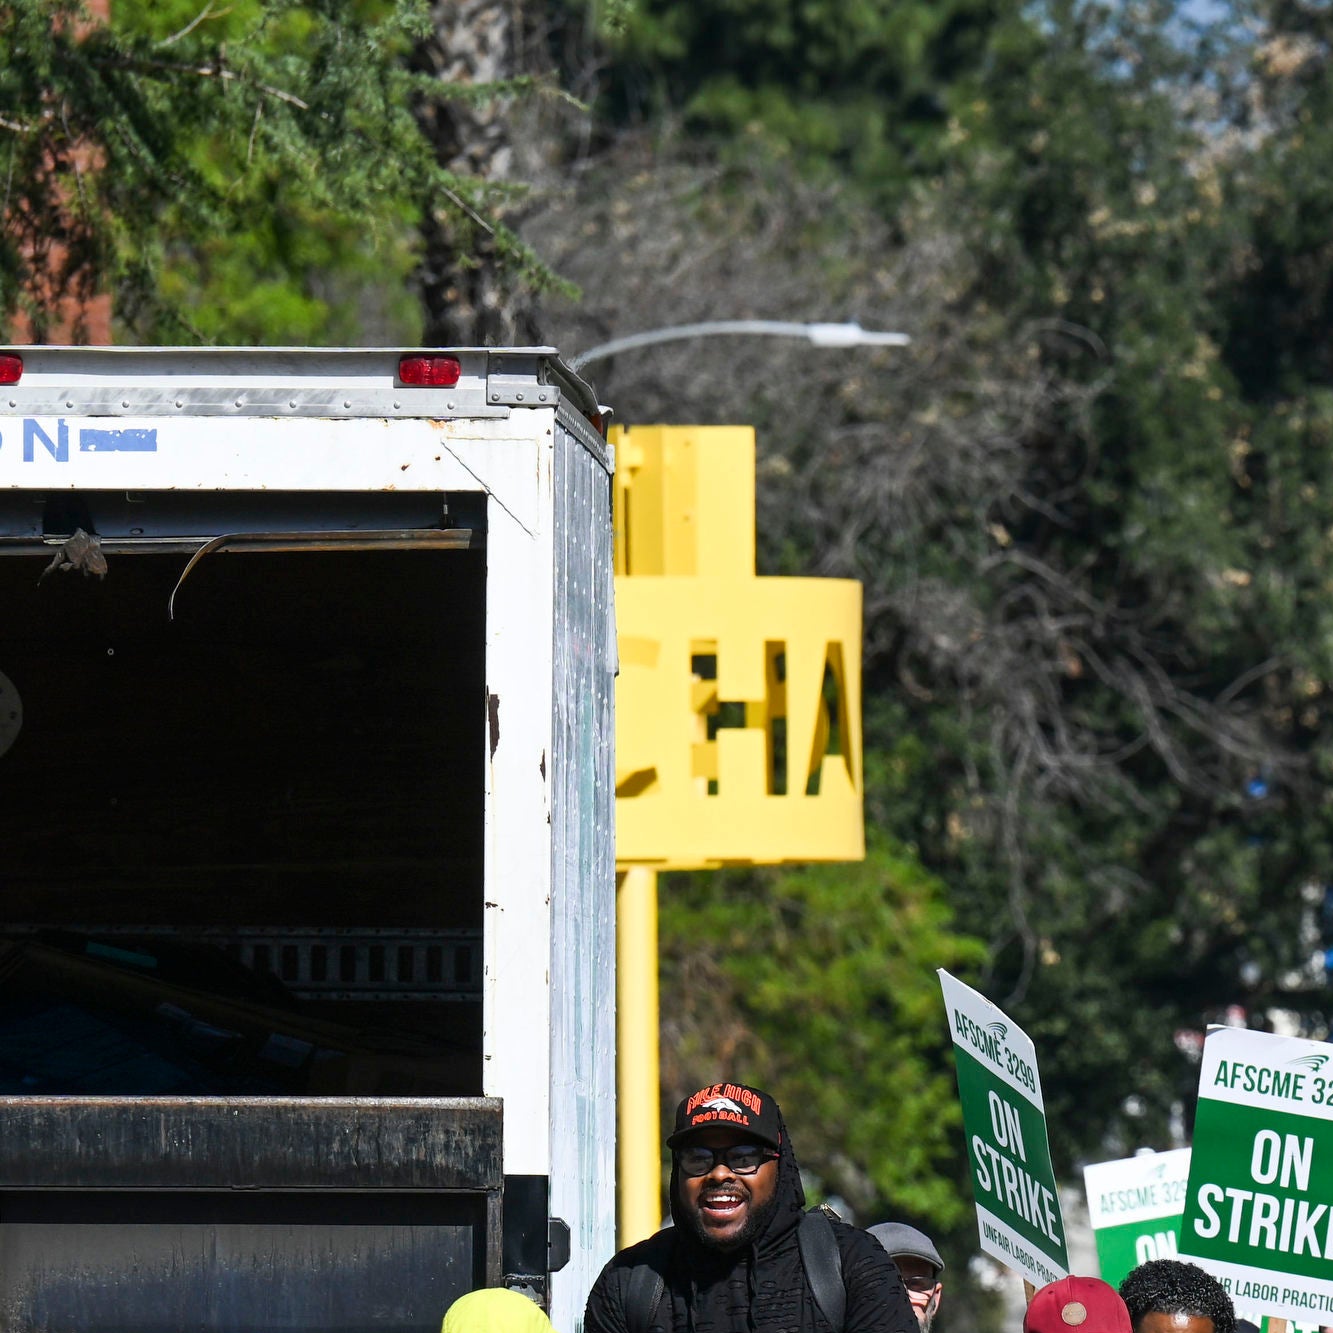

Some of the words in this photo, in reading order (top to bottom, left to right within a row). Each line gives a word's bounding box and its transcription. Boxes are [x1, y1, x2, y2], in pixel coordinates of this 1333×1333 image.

[954, 1009, 1004, 1068] AFSCME
[1005, 1047, 1036, 1094] 3299
[686, 1083, 723, 1116] MILE
[723, 1084, 763, 1116] HIGH
[1214, 1060, 1306, 1101] AFSCME
[691, 1110, 750, 1126] FOOTBALL
[988, 1090, 1027, 1163] ON
[1250, 1129, 1314, 1192] ON
[972, 1135, 1062, 1247] STRIKE
[1101, 1184, 1159, 1215] AFSCME
[983, 1221, 1010, 1254] UNFAIR
[1011, 1242, 1036, 1274] LABOR
[1235, 1279, 1279, 1303] LABOR
